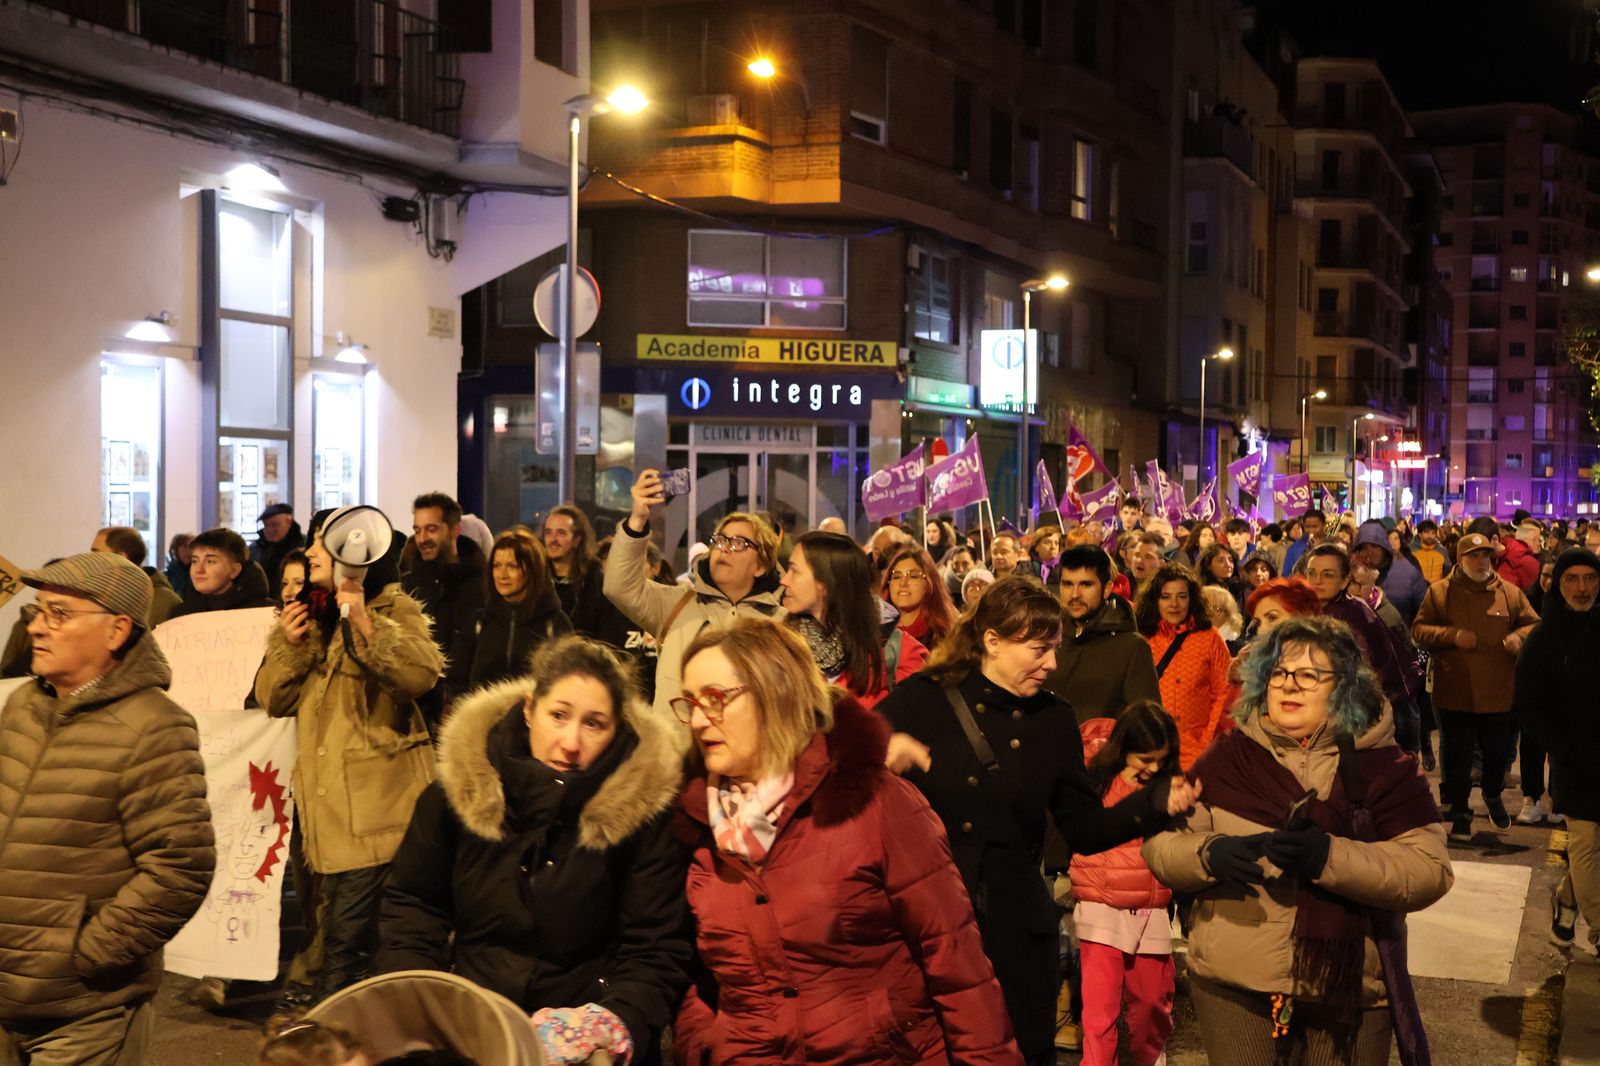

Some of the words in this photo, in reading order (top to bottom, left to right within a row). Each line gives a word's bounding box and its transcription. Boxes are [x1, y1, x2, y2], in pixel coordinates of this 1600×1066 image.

[646, 337, 761, 360] Academia
[779, 341, 885, 363] HIGUERA
[733, 377, 862, 411] integra
[758, 426, 802, 442] DENTAL
